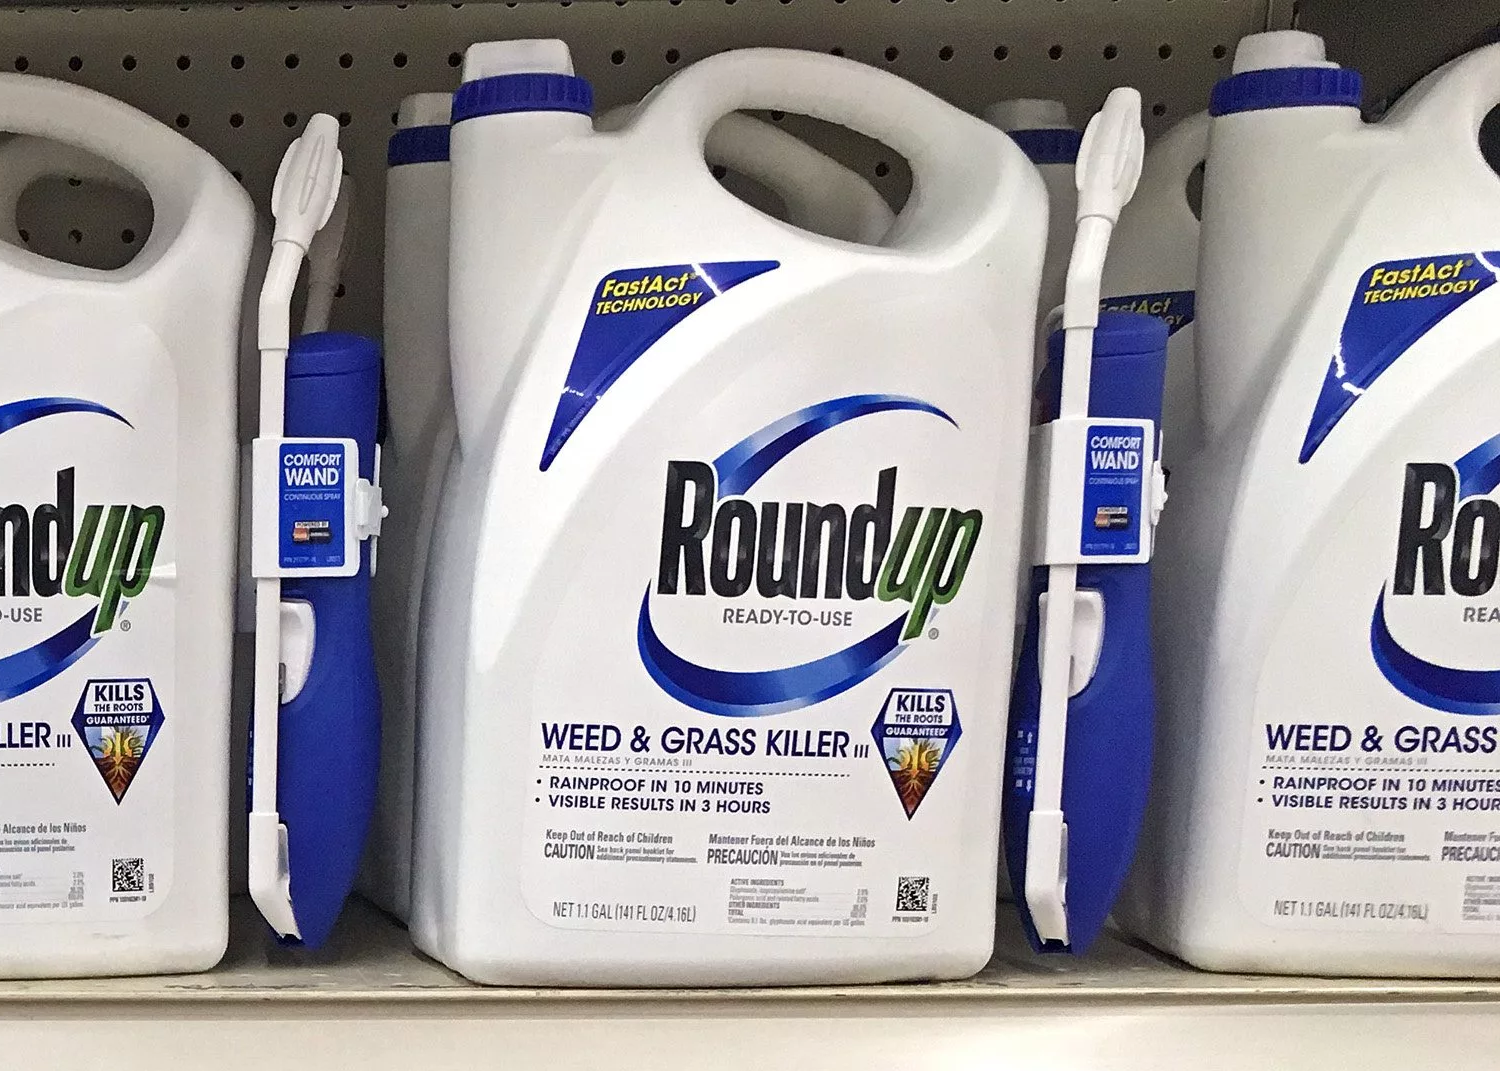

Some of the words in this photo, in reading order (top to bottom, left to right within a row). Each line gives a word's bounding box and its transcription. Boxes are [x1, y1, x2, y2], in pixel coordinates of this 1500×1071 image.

[1370, 261, 1464, 287] FastAct
[603, 274, 688, 297] FastAct
[1364, 280, 1478, 303] TECHNOLOGY
[597, 292, 702, 314] TECHNOLOGY
[1091, 436, 1141, 453] COMFORT
[284, 454, 342, 466] COMFORT
[1091, 451, 1140, 469] WAND
[284, 468, 340, 486] WAND
[657, 460, 984, 643] Roundup
[723, 608, 852, 626] READY-TO-USE
[95, 685, 144, 702] KILLS
[897, 695, 945, 713] KILLS
[87, 716, 147, 724] GUARANTEED
[542, 723, 621, 751] WEED
[630, 726, 650, 752] &
[661, 727, 756, 755] GRASS
[766, 730, 849, 757] KILLER
[1266, 724, 1351, 751] WEED
[1361, 725, 1383, 752] &
[1395, 726, 1497, 753] GRASS
[550, 776, 645, 791] RAINPROOF
[651, 780, 667, 792] IN
[675, 781, 691, 793] 10
[697, 781, 763, 795] MINUTES
[549, 795, 605, 809] VISIBLE
[612, 797, 674, 811] RESULTS
[680, 799, 696, 811] IN
[702, 800, 710, 812] 3
[717, 800, 770, 813] HOURS
